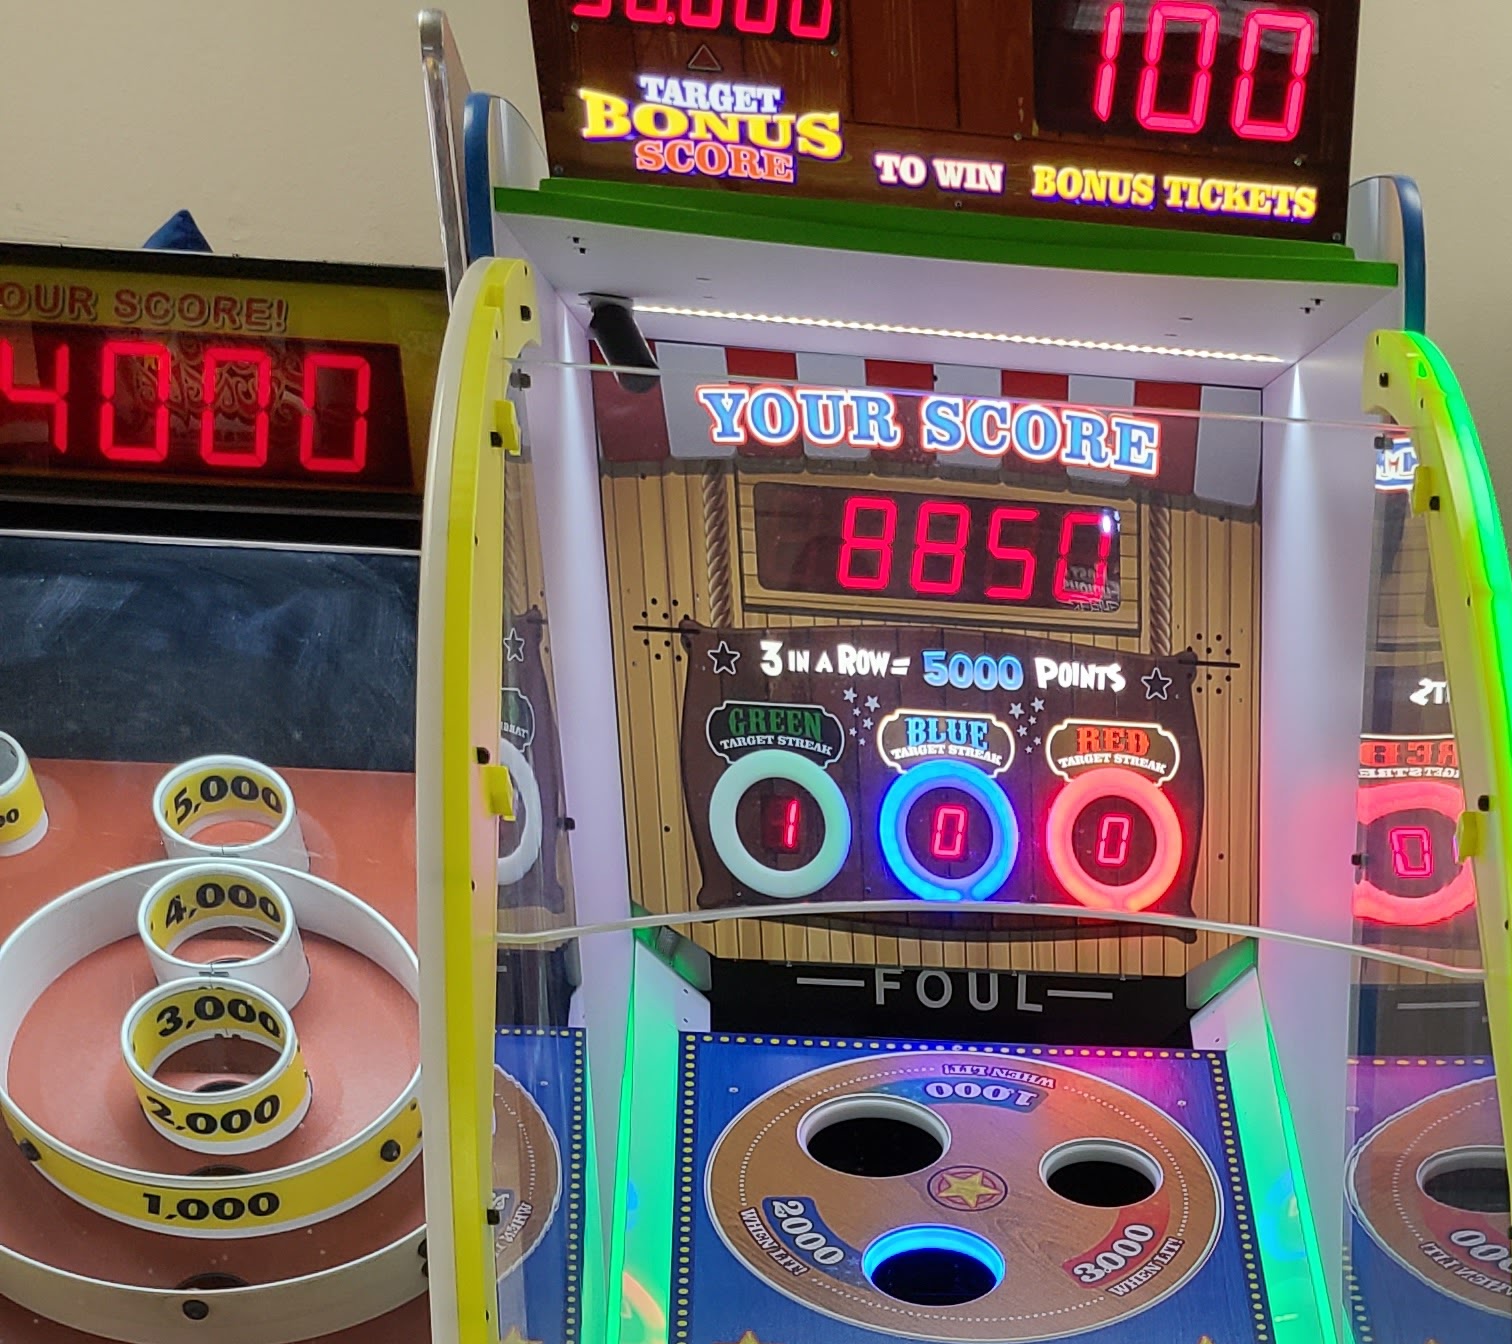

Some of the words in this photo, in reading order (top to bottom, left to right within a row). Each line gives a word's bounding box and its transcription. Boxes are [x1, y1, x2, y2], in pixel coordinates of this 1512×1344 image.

[1093, 1, 1317, 142] 100
[639, 75, 782, 114] TARGET
[578, 88, 843, 160] BONUS
[634, 140, 795, 184] SCORE
[875, 154, 926, 187] TO
[932, 158, 1004, 195] WIN
[1031, 164, 1155, 207] BONUS
[1163, 175, 1317, 222] TICKETS
[111, 289, 289, 333] SCORE!
[696, 385, 901, 448] YOUR
[920, 394, 1161, 476] SCORE
[836, 496, 1113, 605] 8850
[759, 639, 784, 677] 3
[787, 649, 810, 674] IN
[815, 653, 834, 674] A
[921, 648, 1025, 691] 5000
[1033, 656, 1128, 694] POINTS
[718, 735, 774, 752] TARGET
[776, 734, 834, 757] STREAK
[727, 705, 824, 743] GREEN
[904, 715, 990, 751] BLUE
[1075, 725, 1151, 757] RED
[890, 743, 946, 761] TARGET
[948, 744, 1003, 767] STREAK
[1057, 751, 1111, 770] TARGET
[1113, 753, 1168, 776] STREAK
[171, 774, 284, 826] 5,000
[783, 799, 800, 850] 1
[929, 805, 968, 861] 0
[1096, 813, 1131, 867] 0
[164, 881, 282, 928] 4,000
[874, 969, 1044, 1013] FOUL
[156, 994, 282, 1038] 3,000
[990, 1066, 1057, 1090] WHEN
[141, 1191, 281, 1222] 1,000
[739, 1207, 781, 1251] WHEN
[1106, 1261, 1164, 1298] WHEN
